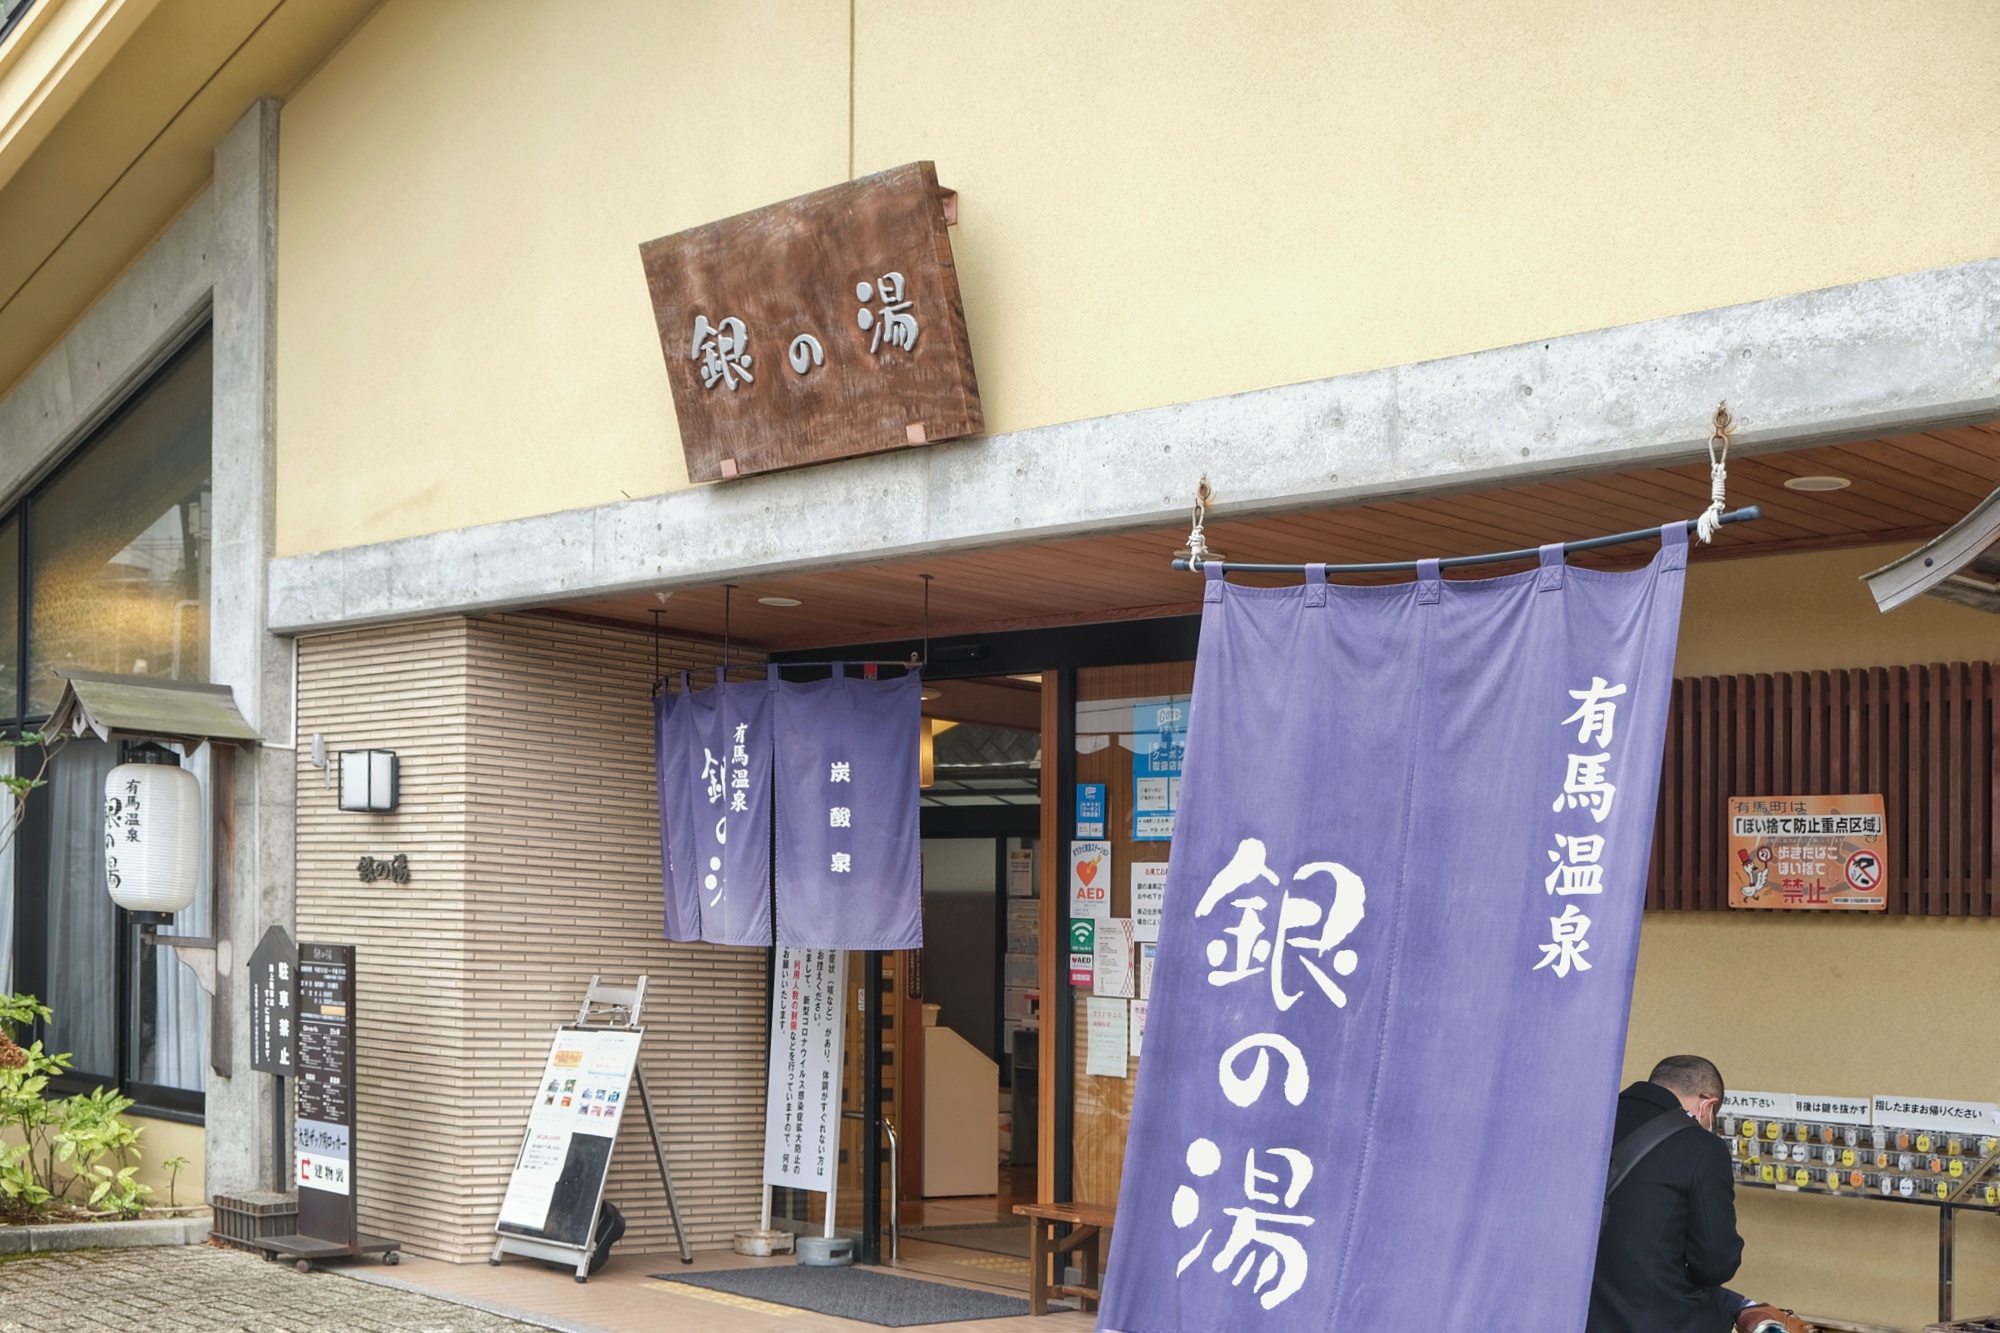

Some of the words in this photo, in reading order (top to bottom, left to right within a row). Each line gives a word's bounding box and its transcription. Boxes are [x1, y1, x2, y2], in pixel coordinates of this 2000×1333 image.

[692, 272, 919, 391] 銀の湯
[730, 722, 749, 812] 有馬温泉
[125, 779, 141, 843] 有馬温泉
[830, 762, 851, 873] 炭酸泉
[1532, 676, 1627, 978] 有馬温泉
[1734, 801, 1807, 814] 有馬町は
[1736, 816, 1881, 834] 「ぽい捨て防止重点区域」
[1778, 846, 1838, 860] 歩きたばこ
[1782, 878, 1828, 904] 禁止
[1077, 888, 1104, 899] AED
[278, 962, 290, 1065] 駐車禁止
[1172, 838, 1366, 1310] 銀の湯
